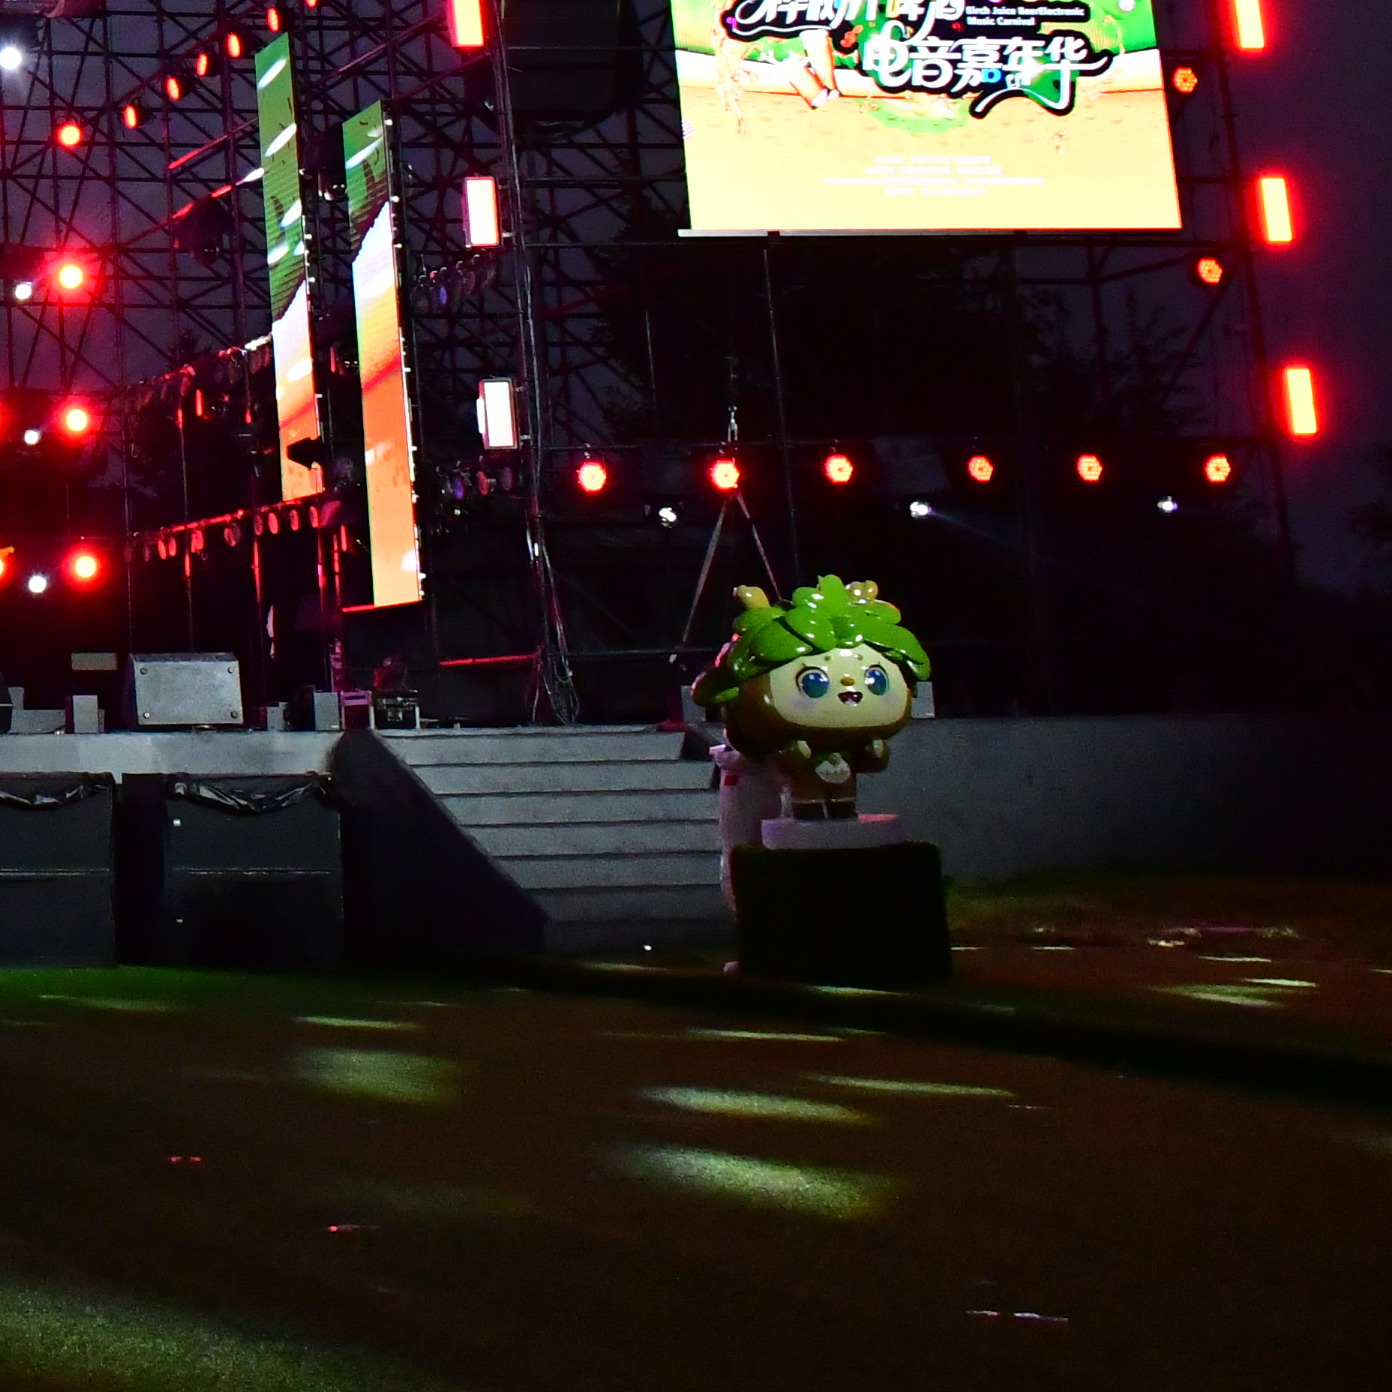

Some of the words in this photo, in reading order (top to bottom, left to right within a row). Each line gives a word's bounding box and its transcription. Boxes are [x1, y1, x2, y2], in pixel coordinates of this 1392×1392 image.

[864, 24, 1108, 108] 电音嘉年华
